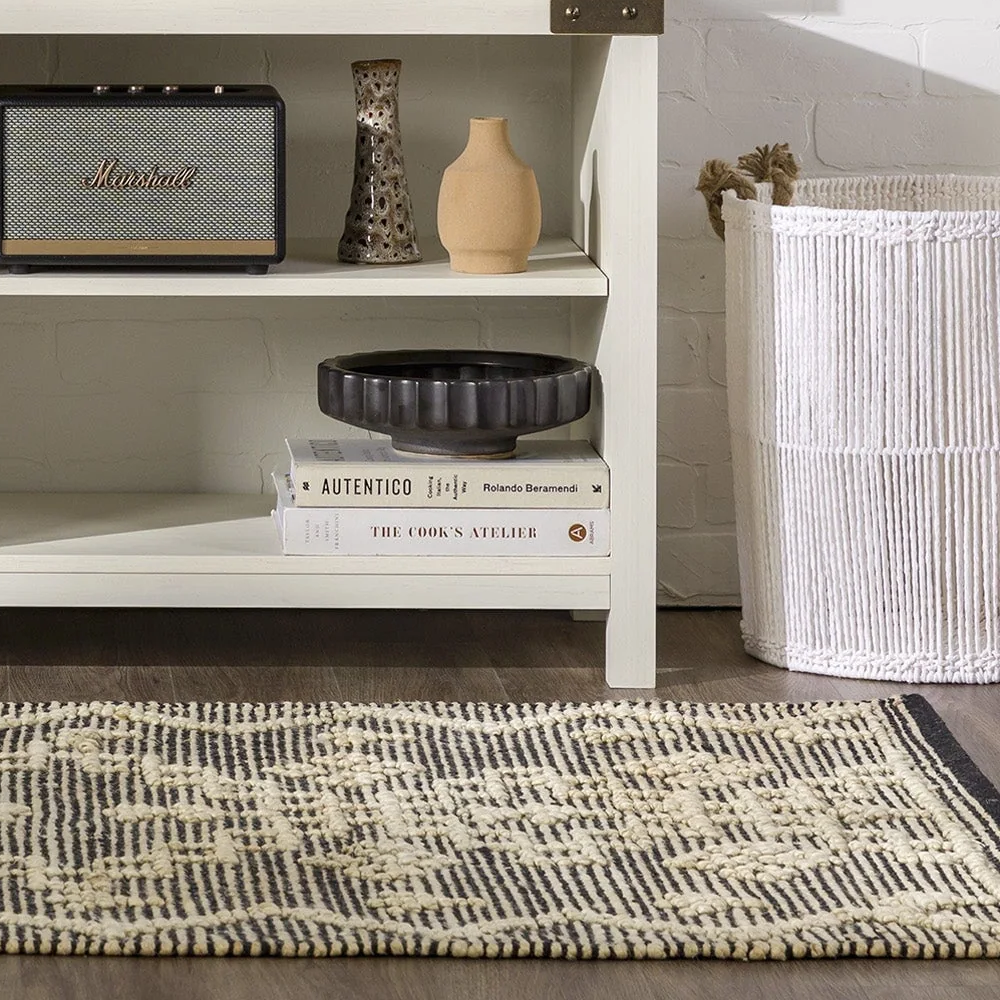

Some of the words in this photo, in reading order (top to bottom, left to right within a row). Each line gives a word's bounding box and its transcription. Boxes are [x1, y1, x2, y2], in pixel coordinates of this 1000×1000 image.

[81, 159, 197, 189] Marshall
[321, 478, 412, 495] AUTENTICO
[483, 483, 523, 493] Rolando
[525, 484, 578, 493] Beramendi
[370, 526, 401, 538] THE
[469, 526, 537, 539] ATELIER
